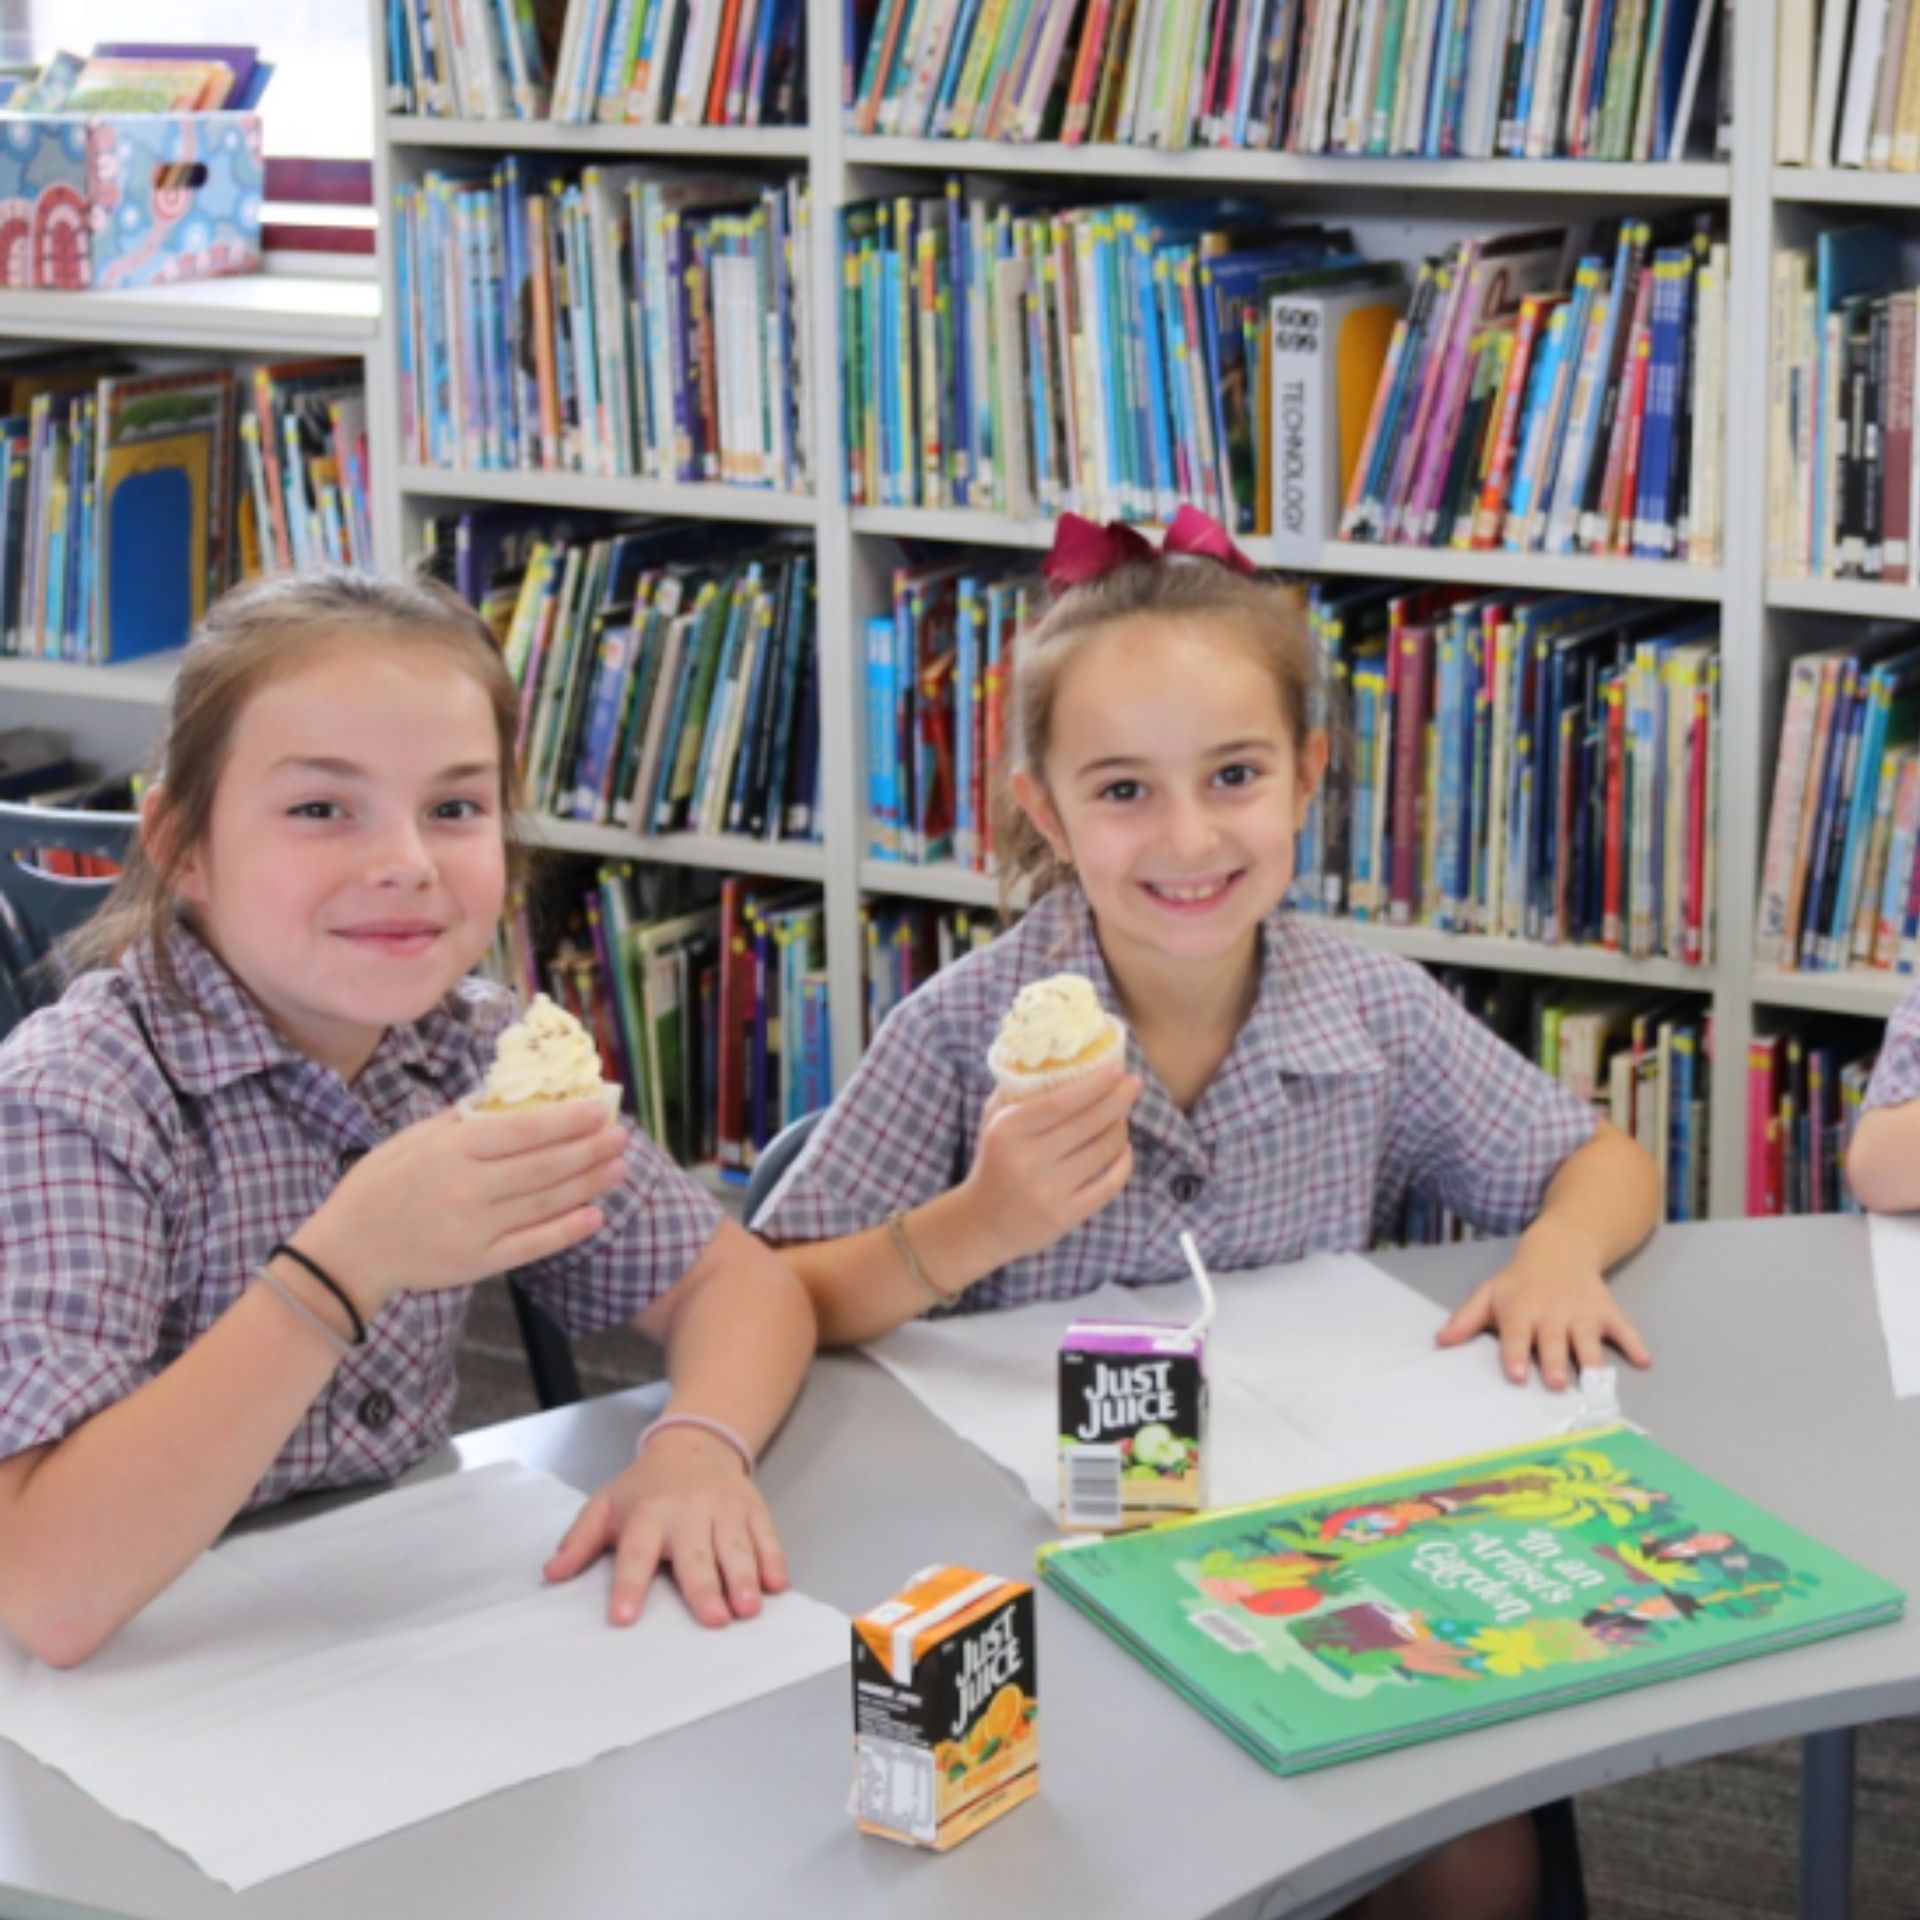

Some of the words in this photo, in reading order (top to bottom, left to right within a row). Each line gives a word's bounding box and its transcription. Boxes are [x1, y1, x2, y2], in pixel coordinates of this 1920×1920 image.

[1281, 379, 1305, 535] TECHNOLOGY
[1083, 1360, 1173, 1401] JUST
[1410, 1540, 1533, 1623] Garden
[1516, 1528, 1563, 1559] In
[1552, 1559, 1606, 1590] an
